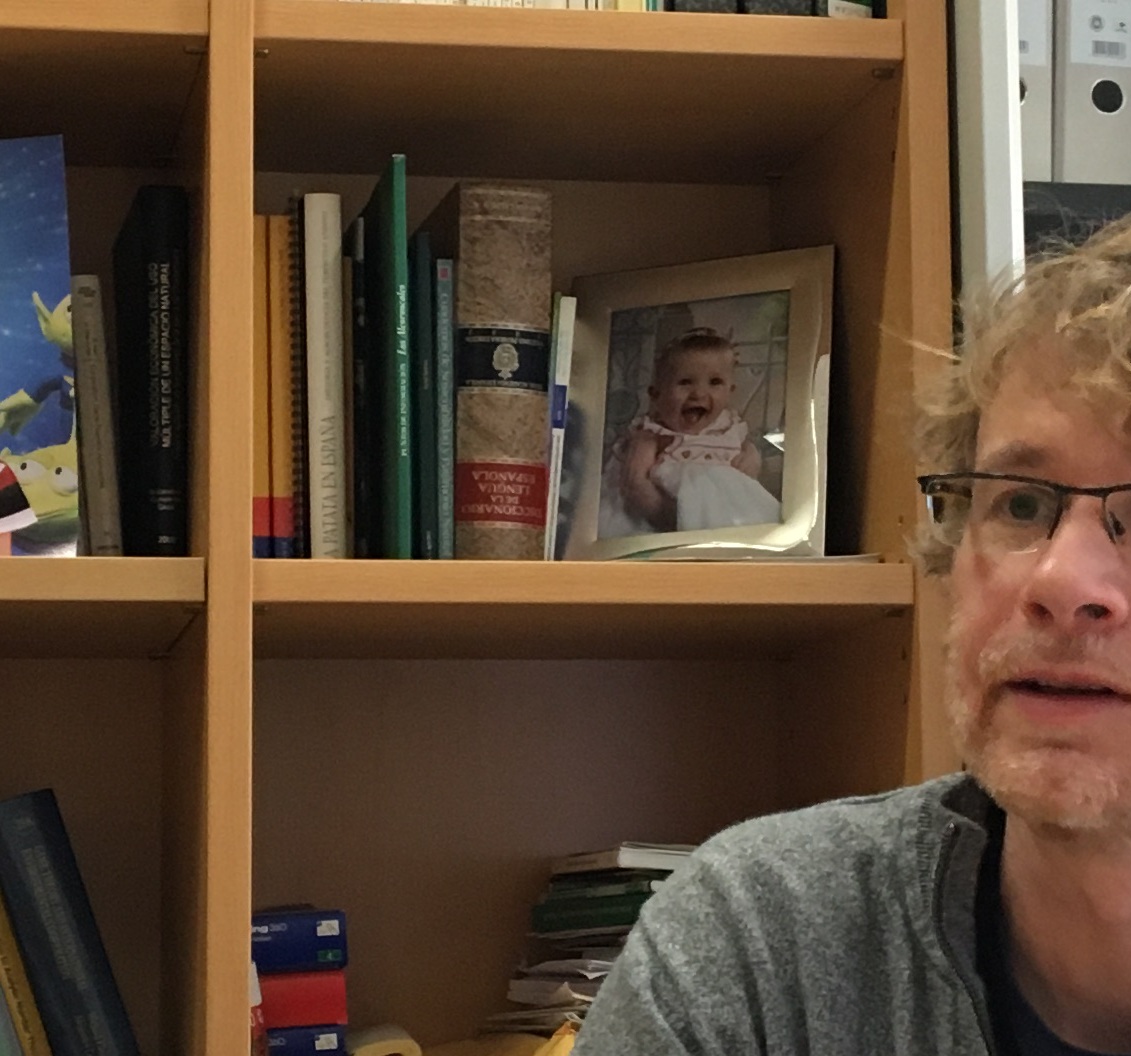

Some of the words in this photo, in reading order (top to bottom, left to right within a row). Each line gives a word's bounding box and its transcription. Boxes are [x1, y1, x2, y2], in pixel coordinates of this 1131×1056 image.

[160, 263, 170, 310] NATURAL
[160, 312, 170, 359] ESPACIO
[160, 361, 170, 377] UN
[160, 379, 171, 394] DE
[318, 415, 336, 466] ESPAÑA
[321, 471, 337, 489] EN
[322, 494, 338, 544] PATATA
